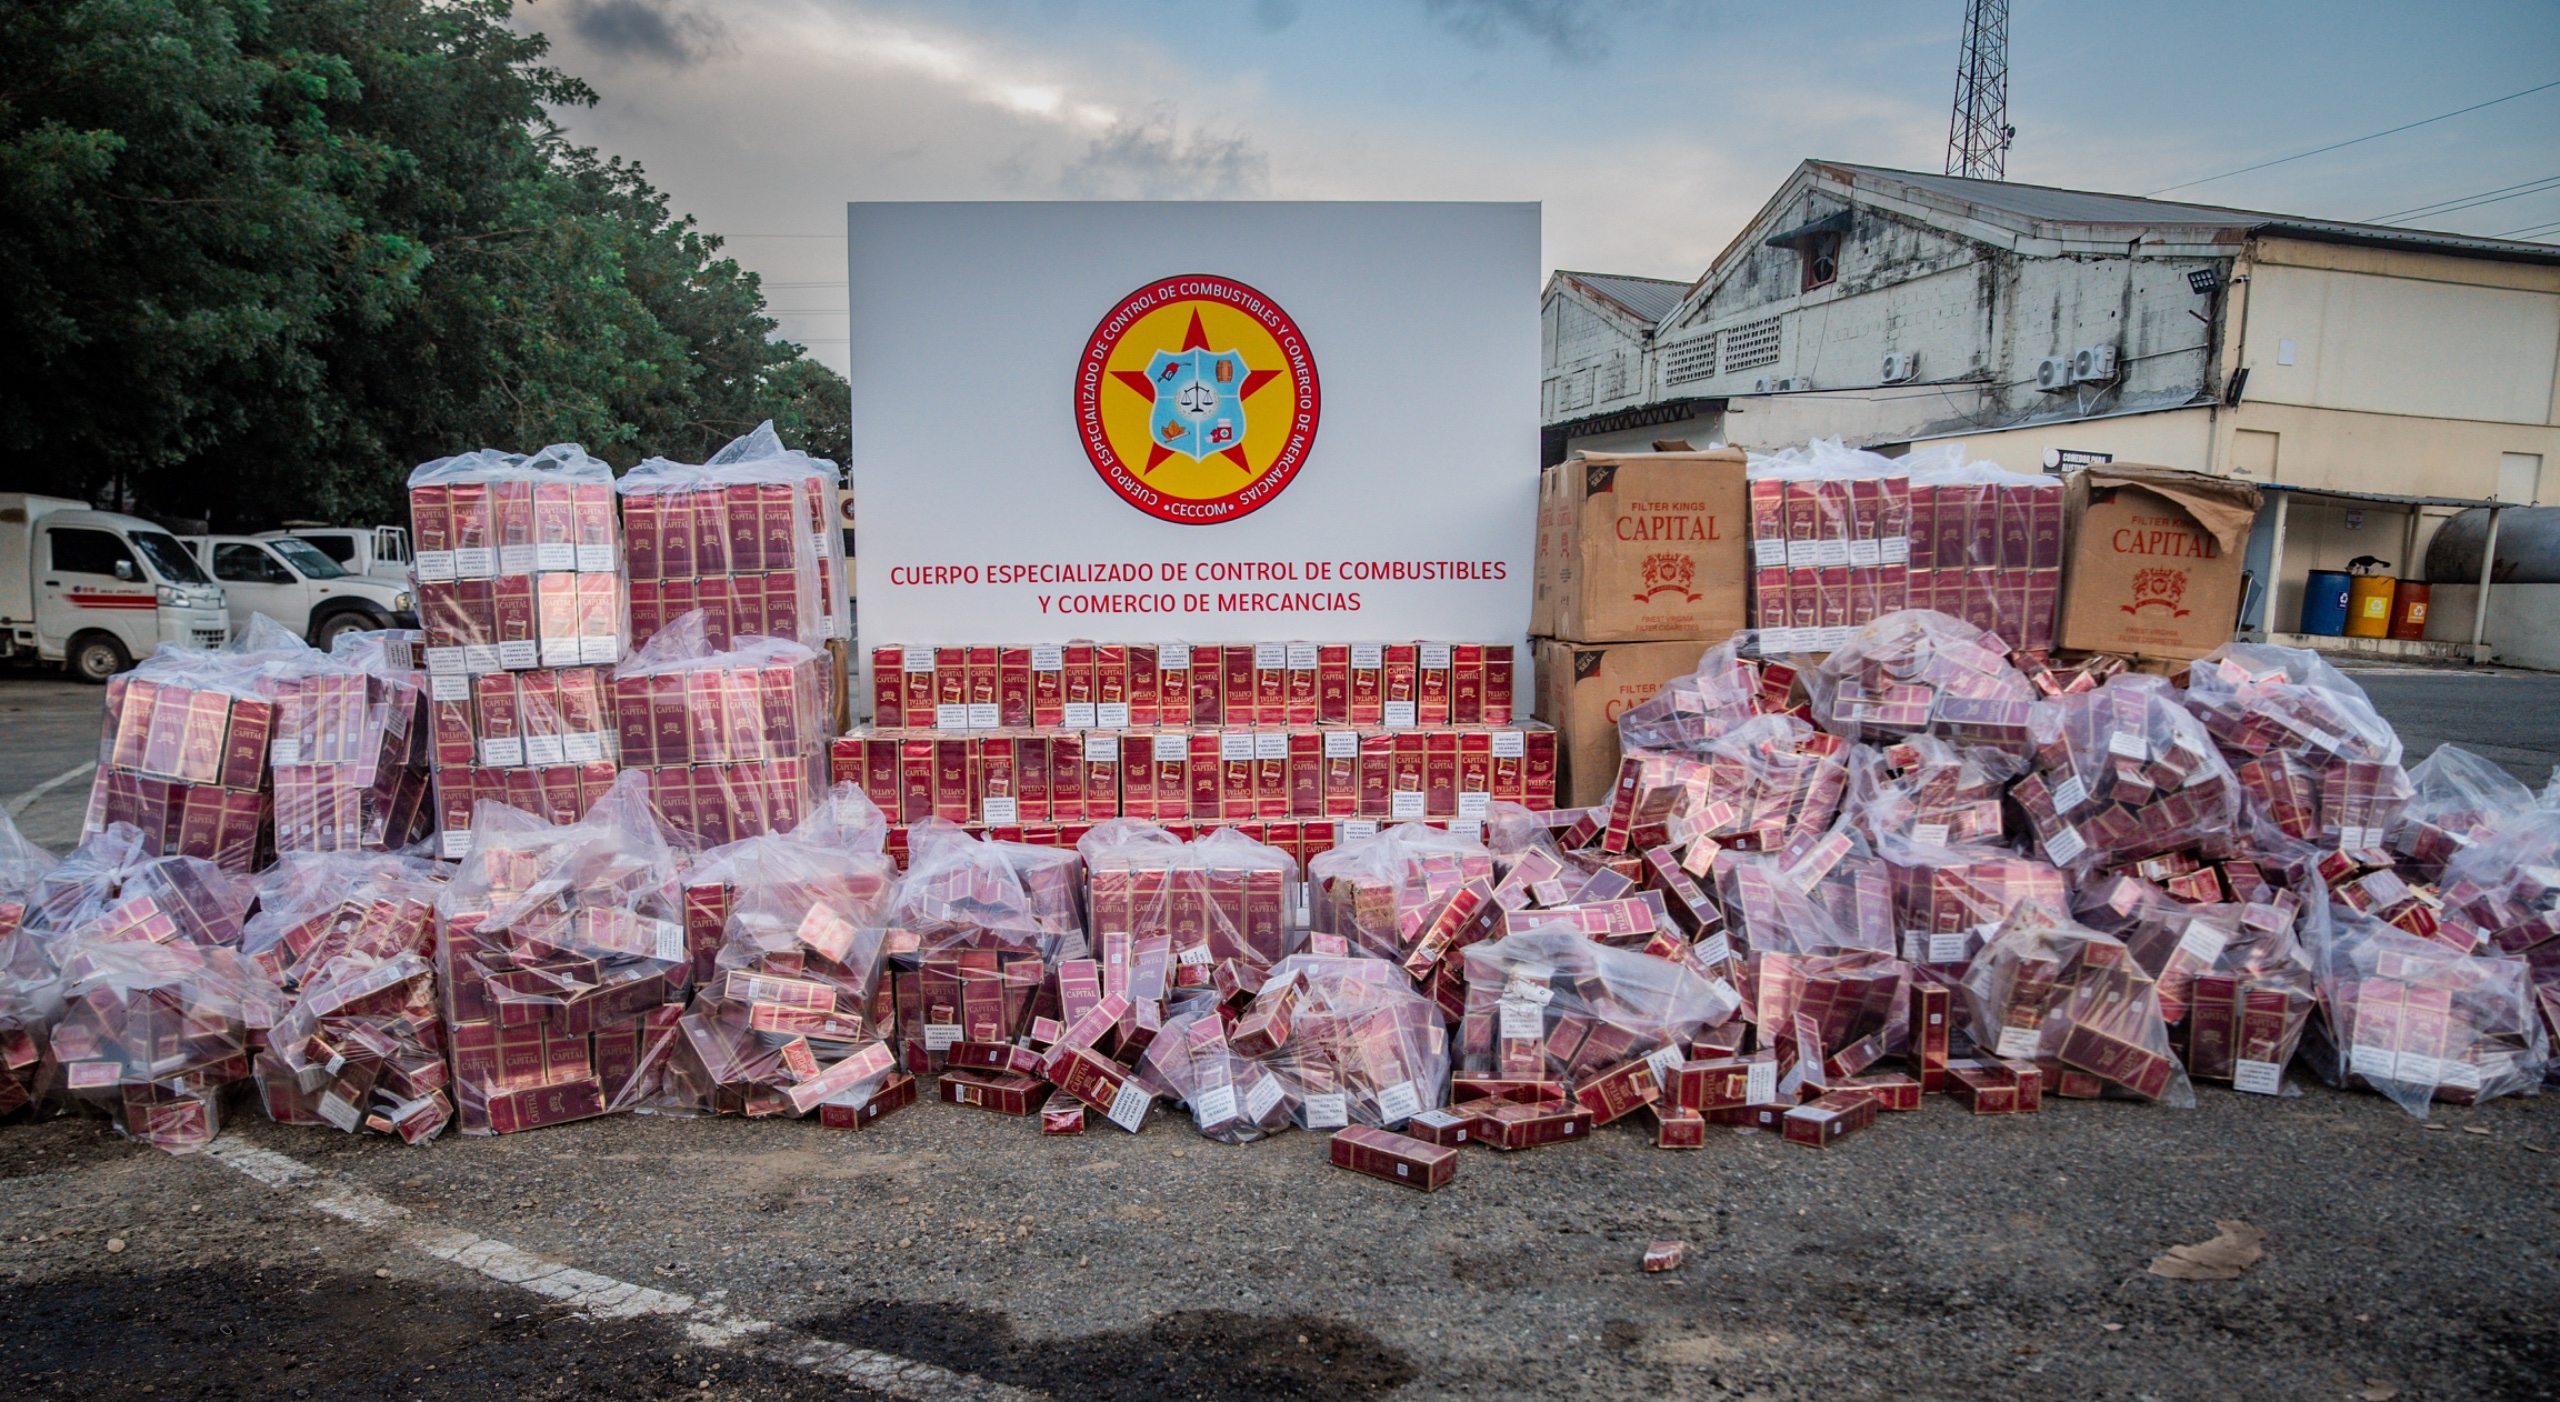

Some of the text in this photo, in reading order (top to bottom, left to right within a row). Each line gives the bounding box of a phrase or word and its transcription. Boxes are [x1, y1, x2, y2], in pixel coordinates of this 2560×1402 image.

[1083, 282, 1312, 505] CUERPO ESPECIALIZADO DE CONTROL DE COMBUSTIBLES Y COMERCIO DE MERCANCIAS
[1591, 469, 1609, 487] SEAL
[1632, 502, 1705, 511] FILTER KINGS
[456, 508, 486, 516] CAPITAL
[539, 507, 567, 515] CAPITAL
[416, 511, 446, 520] CAPITAL
[730, 513, 757, 521] CAPITAL
[764, 512, 790, 520] CAPITAL
[629, 522, 654, 530] CAPITAL
[2132, 516, 2199, 528] FILTER KING
[1616, 516, 1721, 541] CAPITAL
[2113, 529, 2217, 559] CAPITAL
[891, 561, 1507, 585] CUERPO ESPECIALIZADO DE CONTROL DE COMBUSTIBLES
[499, 601, 528, 609] CAPITAL
[544, 599, 572, 607] CAPITAL
[582, 599, 611, 607] CAPITAL
[1037, 593, 1361, 614] Y COMERCIO DE MERCANCIAS
[734, 606, 760, 614] CAPITAL
[633, 611, 658, 620] CAPITAL
[1635, 624, 1700, 632] FILTER CIGARETTES
[1579, 655, 1596, 672] SEAL
[1195, 673, 1218, 681] CAPITAL
[1456, 672, 1479, 680] CAPITAL
[1620, 684, 1656, 694] FILTER
[485, 699, 512, 707] CAPITAL
[765, 700, 792, 708] CAPITAL
[621, 707, 648, 715] CAPITAL
[656, 705, 684, 713] CAPITAL
[233, 730, 262, 741] CAPITAL
[1397, 756, 1421, 764] CAPITAL
[1462, 756, 1487, 764] CAPITAL
[836, 763, 860, 771] CAPITAL
[985, 761, 1010, 769] CAPITAL
[1192, 763, 1217, 772] CAPITAL
[1293, 763, 1318, 771] CAPITAL
[1363, 762, 1388, 770] CAPITAL
[905, 769, 930, 777] CAPITAL
[442, 792, 470, 800] CAPITAL
[549, 791, 575, 799] CAPITAL
[769, 792, 795, 800] CAPITAL
[663, 798, 689, 807] CAPITAL
[697, 797, 724, 805] CAPITAL
[188, 815, 216, 825] CAPITAL
[226, 822, 253, 831] CAPITAL
[1096, 904, 1125, 914] CAPITAL
[1250, 904, 1279, 913] CAPITAL
[691, 917, 723, 929] CAPITAL
[1065, 989, 1096, 999] CAPITAL
[969, 1005, 999, 1013] CAPITAL
[551, 1051, 585, 1062] CAPITAL
[461, 1059, 496, 1071] CAPITAL
[506, 1055, 539, 1067] CAPITAL
[1071, 1063, 1090, 1092] CAPITAL
[530, 1093, 541, 1123] CAPITAL
